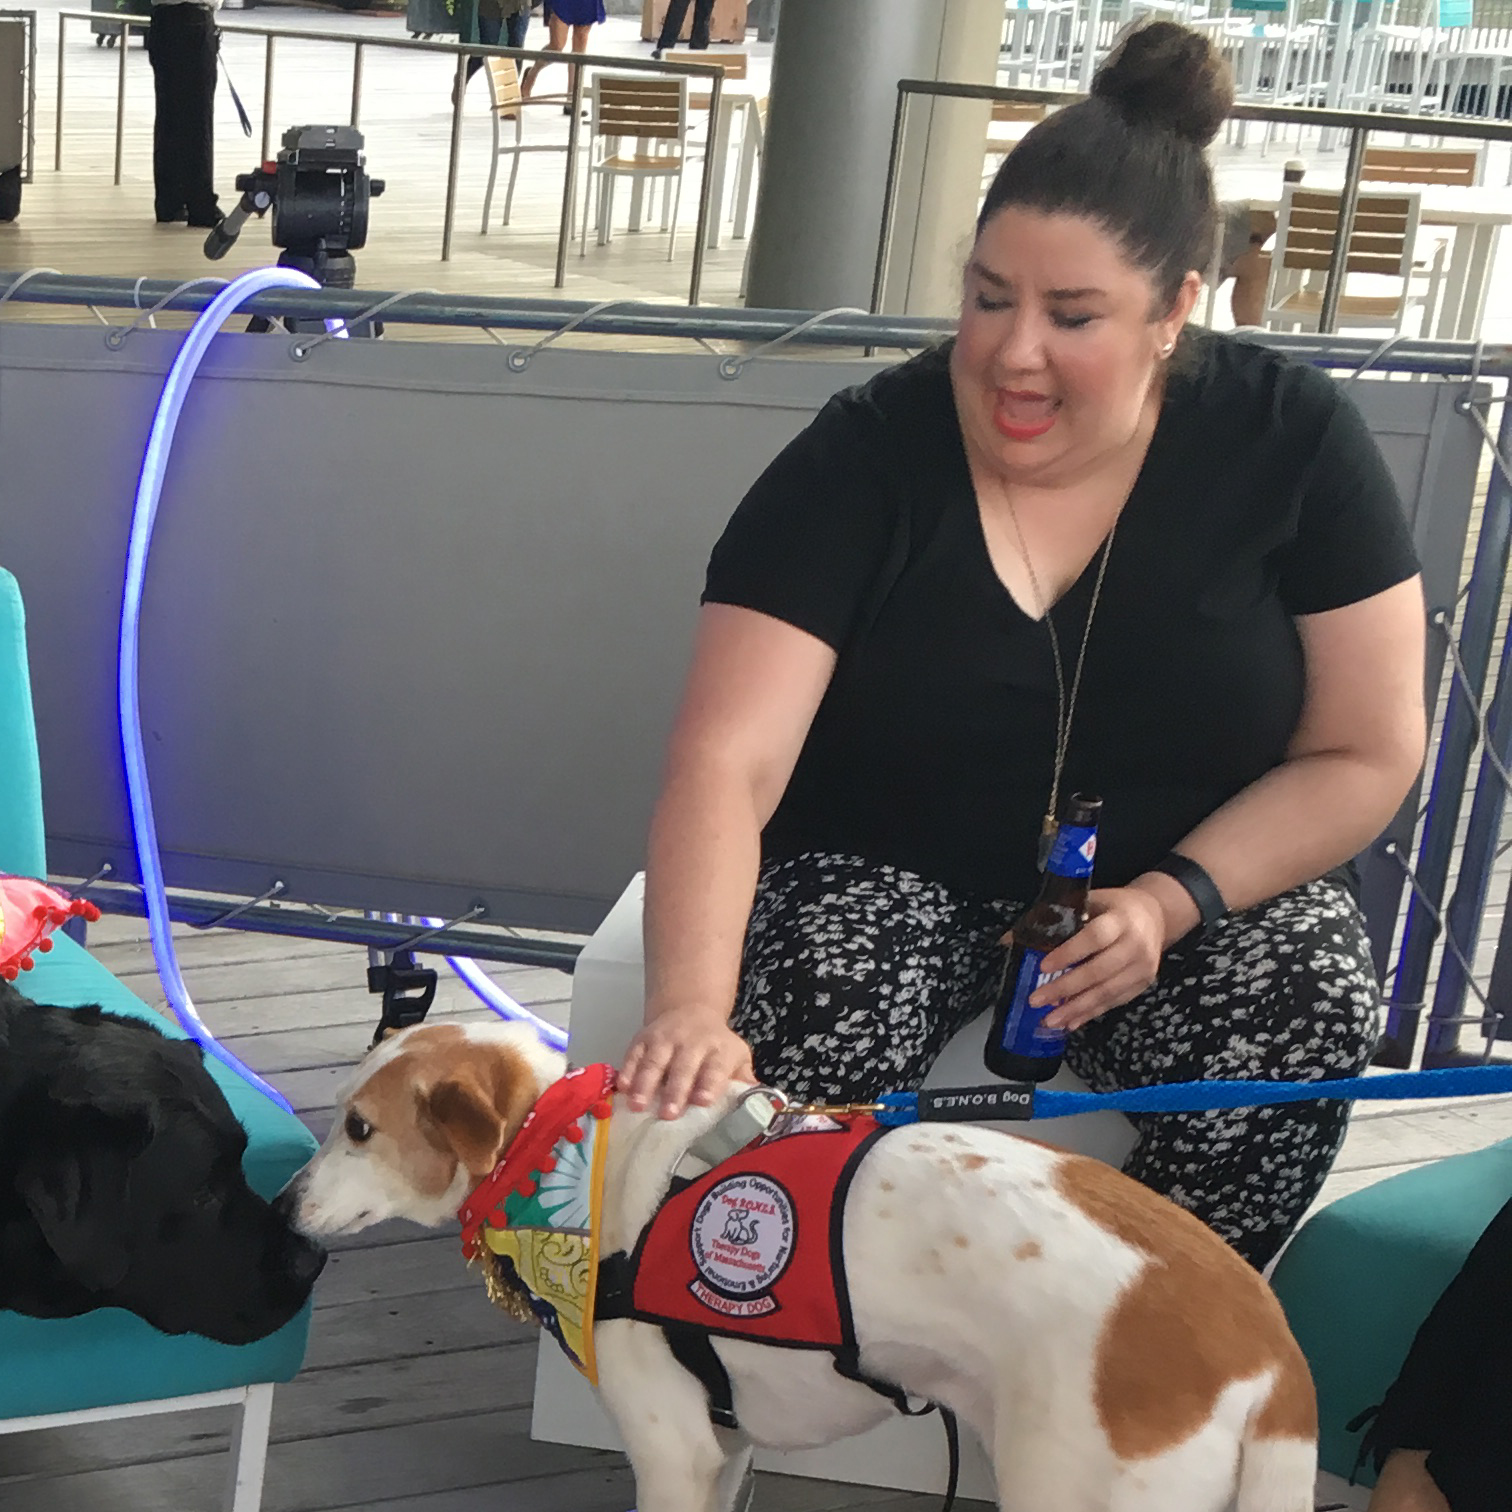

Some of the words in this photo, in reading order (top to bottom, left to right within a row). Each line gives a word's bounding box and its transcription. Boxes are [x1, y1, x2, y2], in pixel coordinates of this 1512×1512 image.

[1002, 1090, 1031, 1105] Dog
[711, 1179, 747, 1200] Building
[721, 1194, 738, 1208] Dog
[749, 1178, 790, 1225] Opportunities
[782, 1227, 791, 1243] for
[694, 1227, 707, 1266] Support
[711, 1238, 740, 1256] Therapy
[740, 1246, 761, 1260] Dogs
[755, 1246, 789, 1284] Nurturing
[694, 1282, 743, 1314] THERAPY
[747, 1298, 772, 1313] DOG
